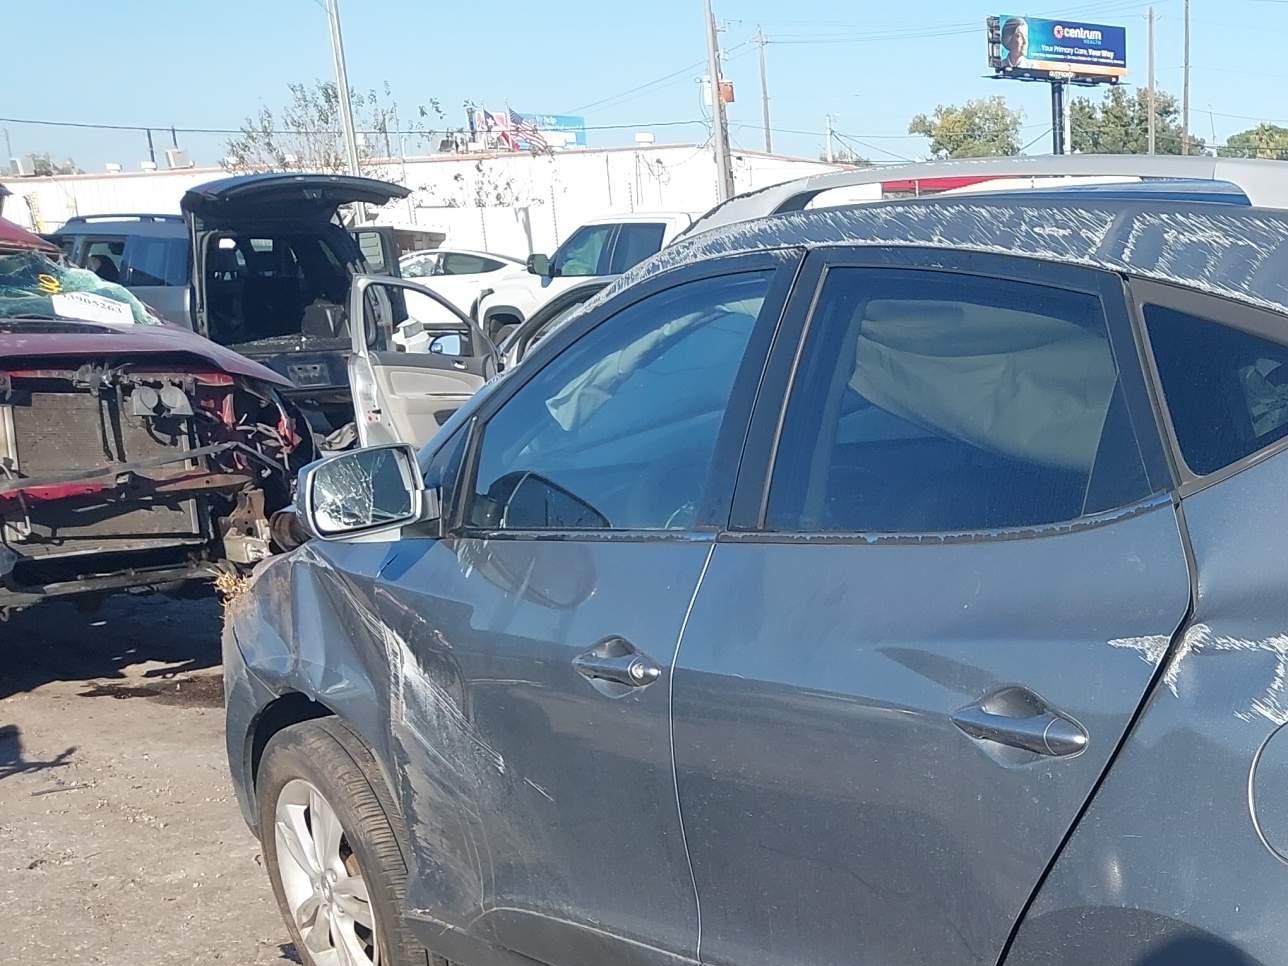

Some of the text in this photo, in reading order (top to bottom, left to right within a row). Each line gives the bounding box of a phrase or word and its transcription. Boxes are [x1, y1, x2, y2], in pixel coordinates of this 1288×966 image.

[1064, 27, 1102, 40] centrum
[1041, 44, 1053, 52] Your
[1054, 46, 1073, 55] Primary
